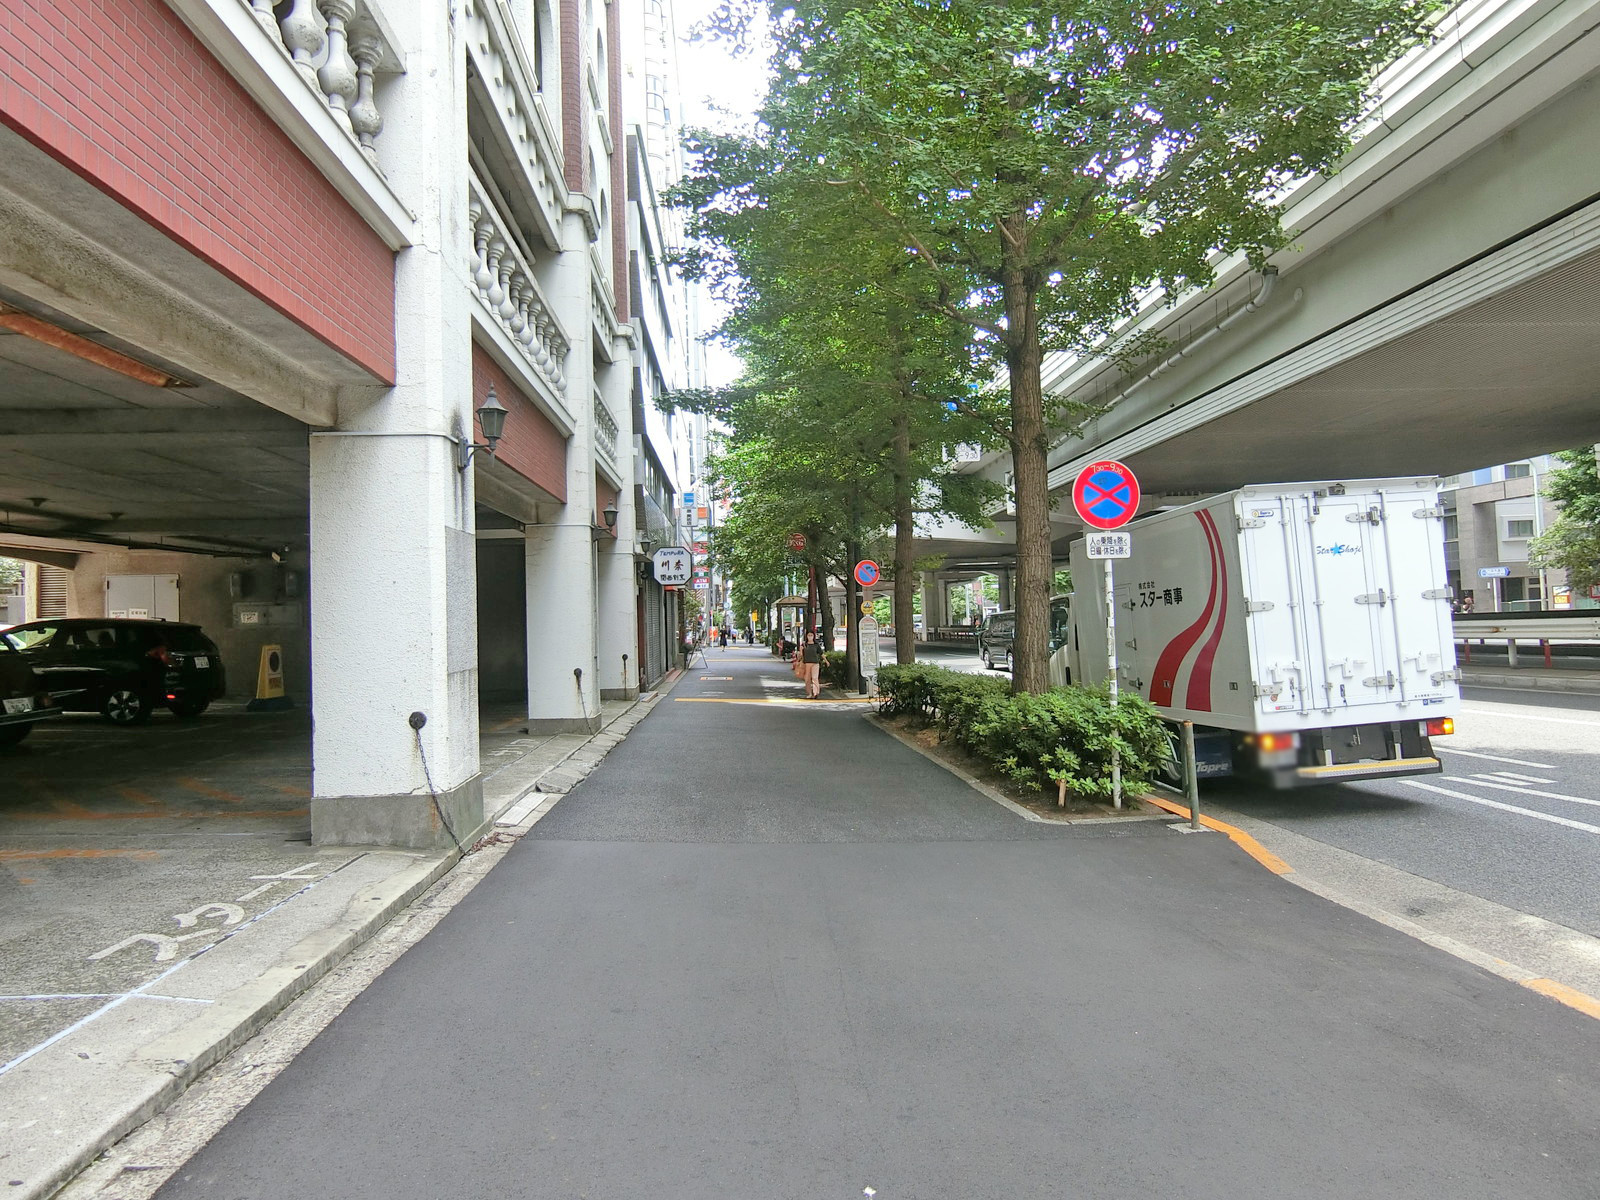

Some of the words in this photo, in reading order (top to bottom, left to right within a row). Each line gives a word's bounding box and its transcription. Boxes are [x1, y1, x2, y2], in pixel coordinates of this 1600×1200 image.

[1337, 544, 1362, 556] Shoji
[1140, 587, 1183, 608] スター商事
[1196, 761, 1229, 773] Topre
